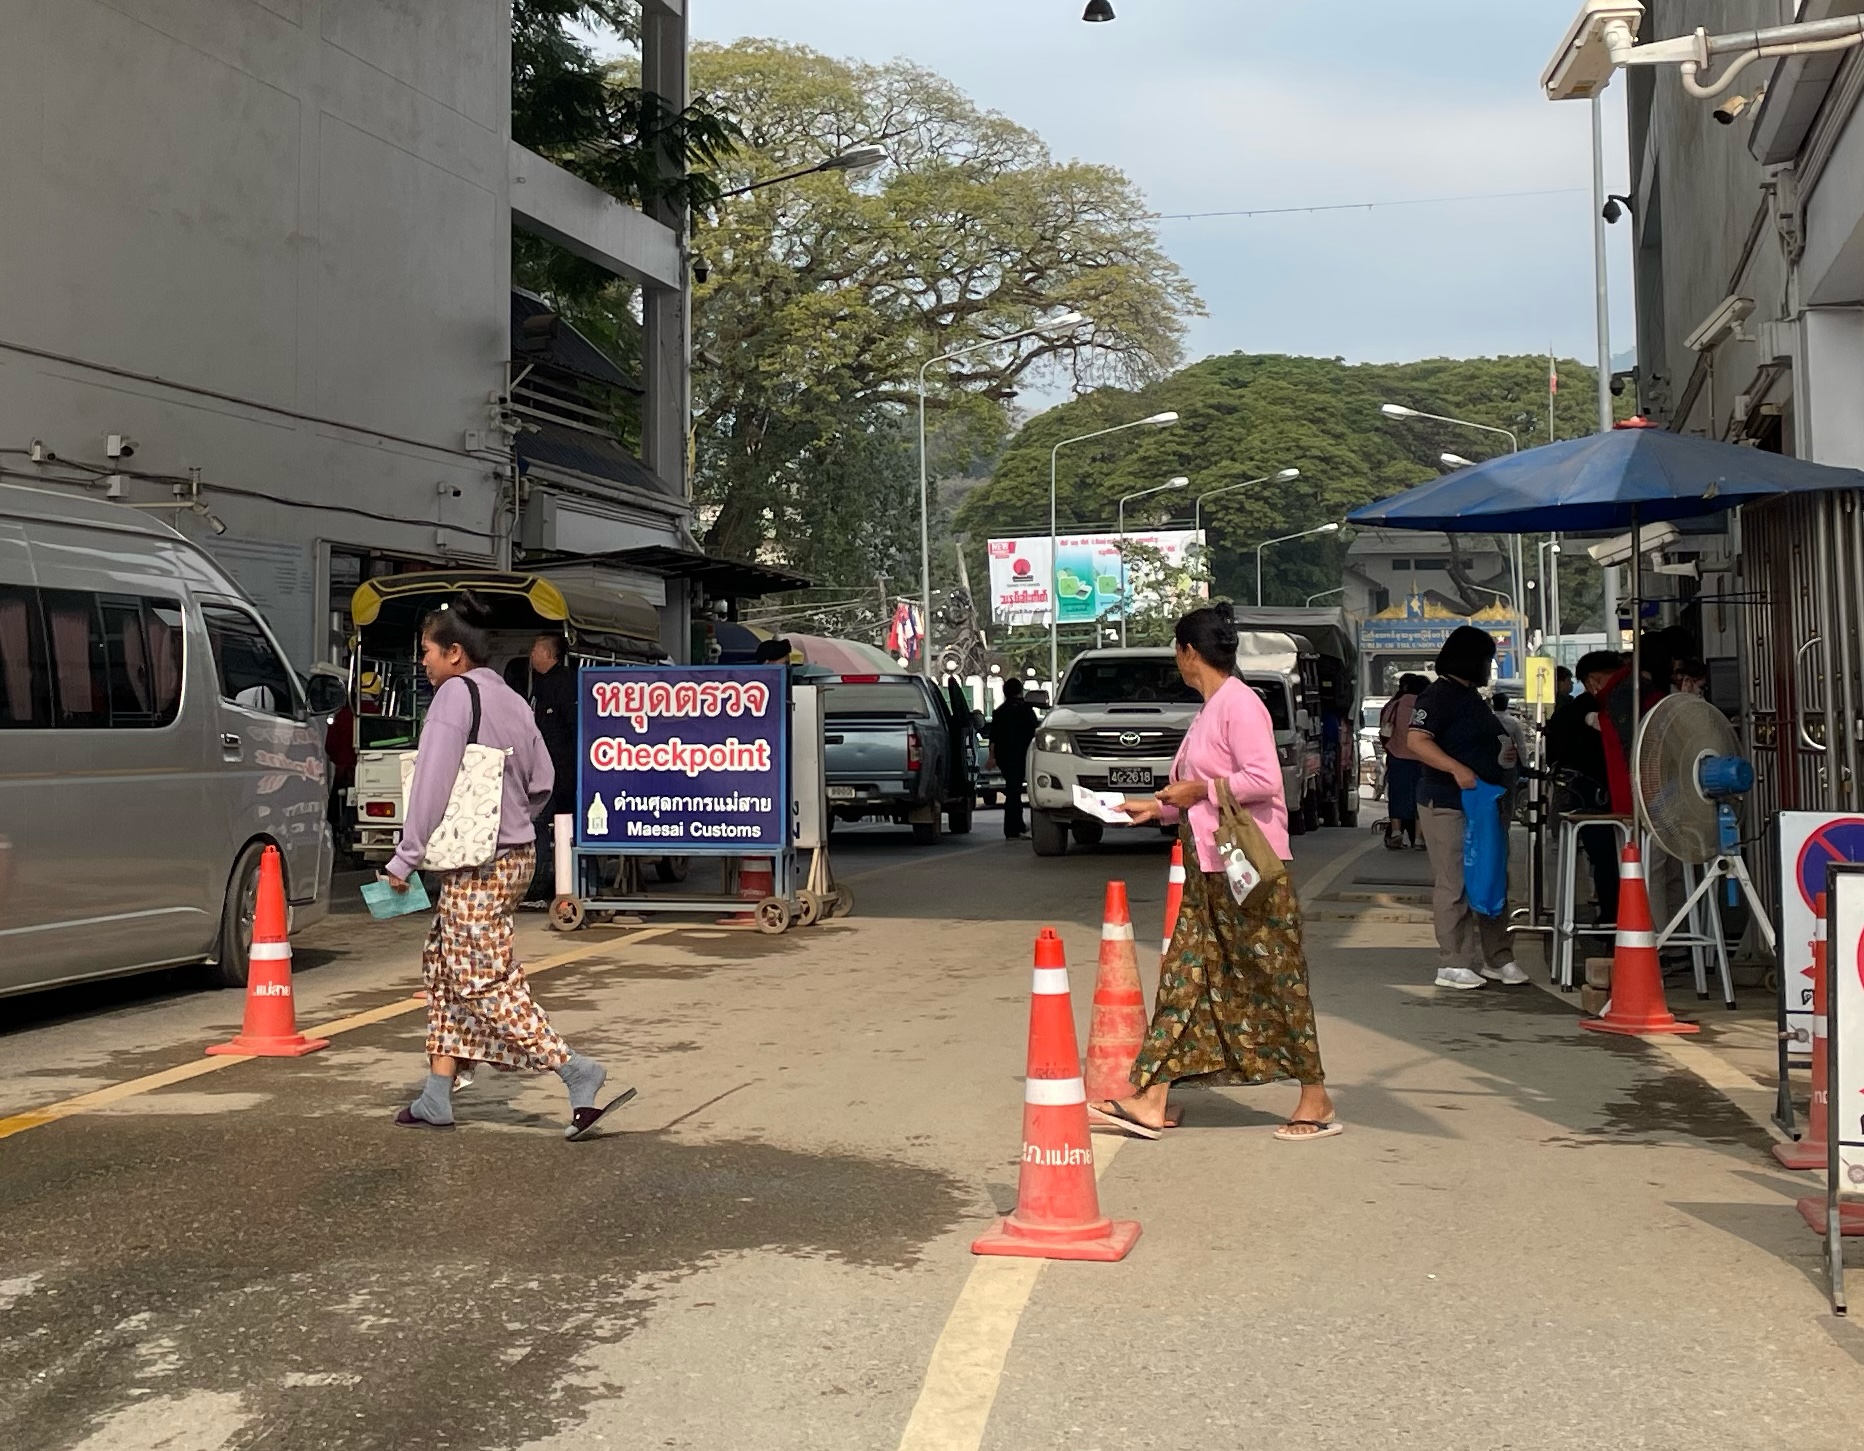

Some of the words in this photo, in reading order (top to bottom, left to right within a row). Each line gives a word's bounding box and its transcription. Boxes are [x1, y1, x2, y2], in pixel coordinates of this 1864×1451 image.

[594, 683, 768, 731] หยุดตรวจ
[592, 738, 769, 775] Checkpoint
[614, 790, 772, 818] ด่านศุลกากรแม่สาย
[627, 821, 684, 836] Maesai
[689, 822, 762, 837] Customs
